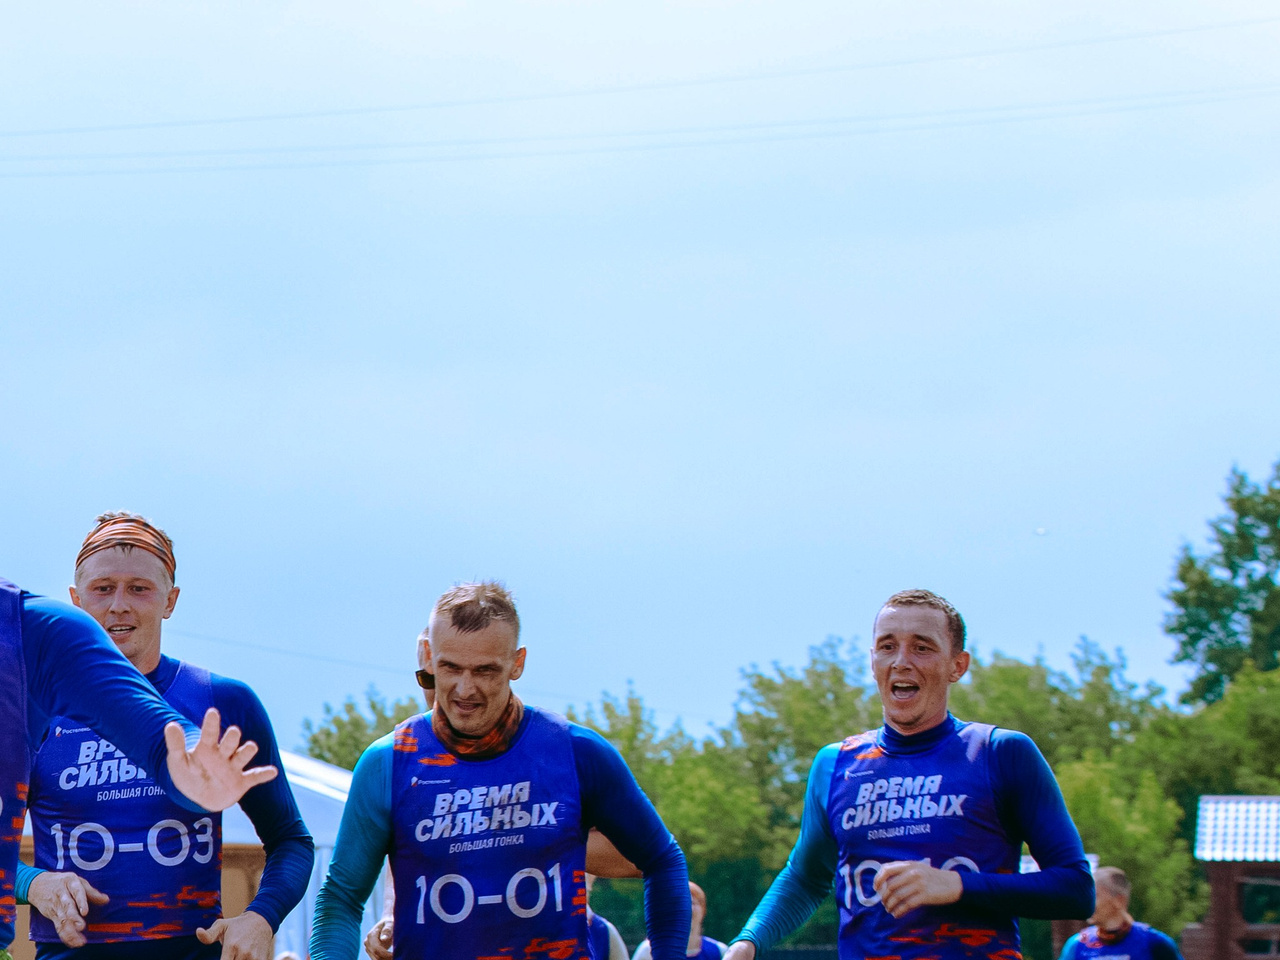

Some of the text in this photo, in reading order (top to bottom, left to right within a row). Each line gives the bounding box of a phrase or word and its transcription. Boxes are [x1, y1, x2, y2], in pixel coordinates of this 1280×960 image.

[97, 787, 141, 801] БОЛЬШАЯ
[433, 781, 531, 817] ВРЕМЯ
[855, 774, 943, 805] ВРЕМЯ
[415, 801, 559, 842] СИЛЬНЫХ
[841, 794, 968, 830] СИЛЬНЫХ
[50, 817, 214, 871] 10-03
[449, 834, 524, 854] БОЛЬШАЯ ГОНКА
[415, 863, 563, 924] 10-01
